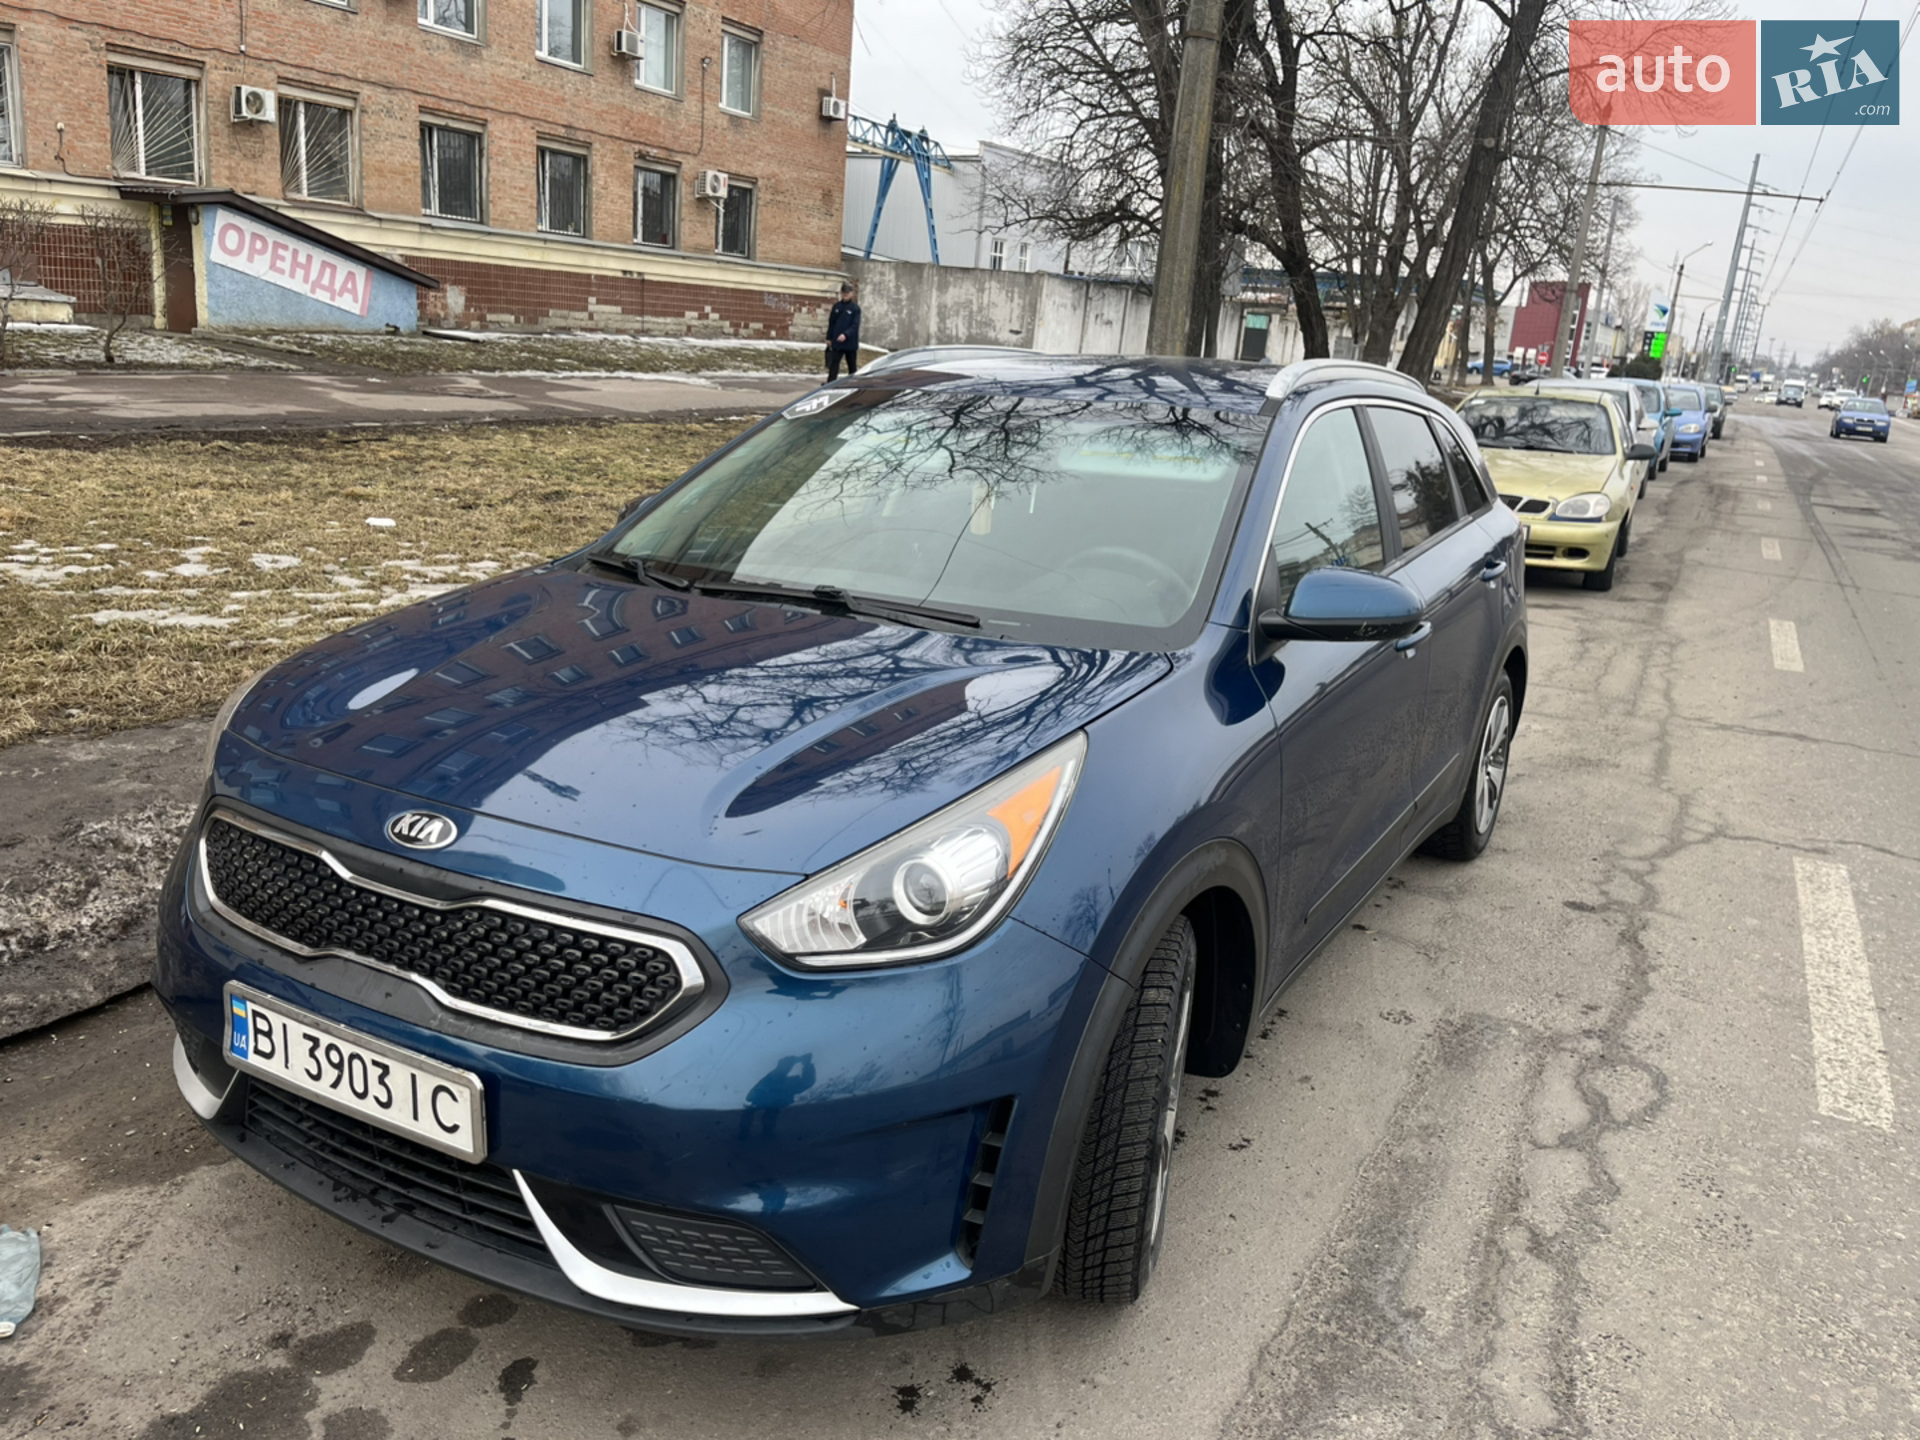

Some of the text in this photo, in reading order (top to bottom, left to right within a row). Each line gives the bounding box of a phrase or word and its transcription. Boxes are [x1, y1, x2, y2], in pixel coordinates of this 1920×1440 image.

[217, 222, 360, 304] ОРЕНДА
[393, 812, 444, 844] KIA
[233, 1031, 248, 1051] UA
[251, 1008, 461, 1134] BI 3903 IC
